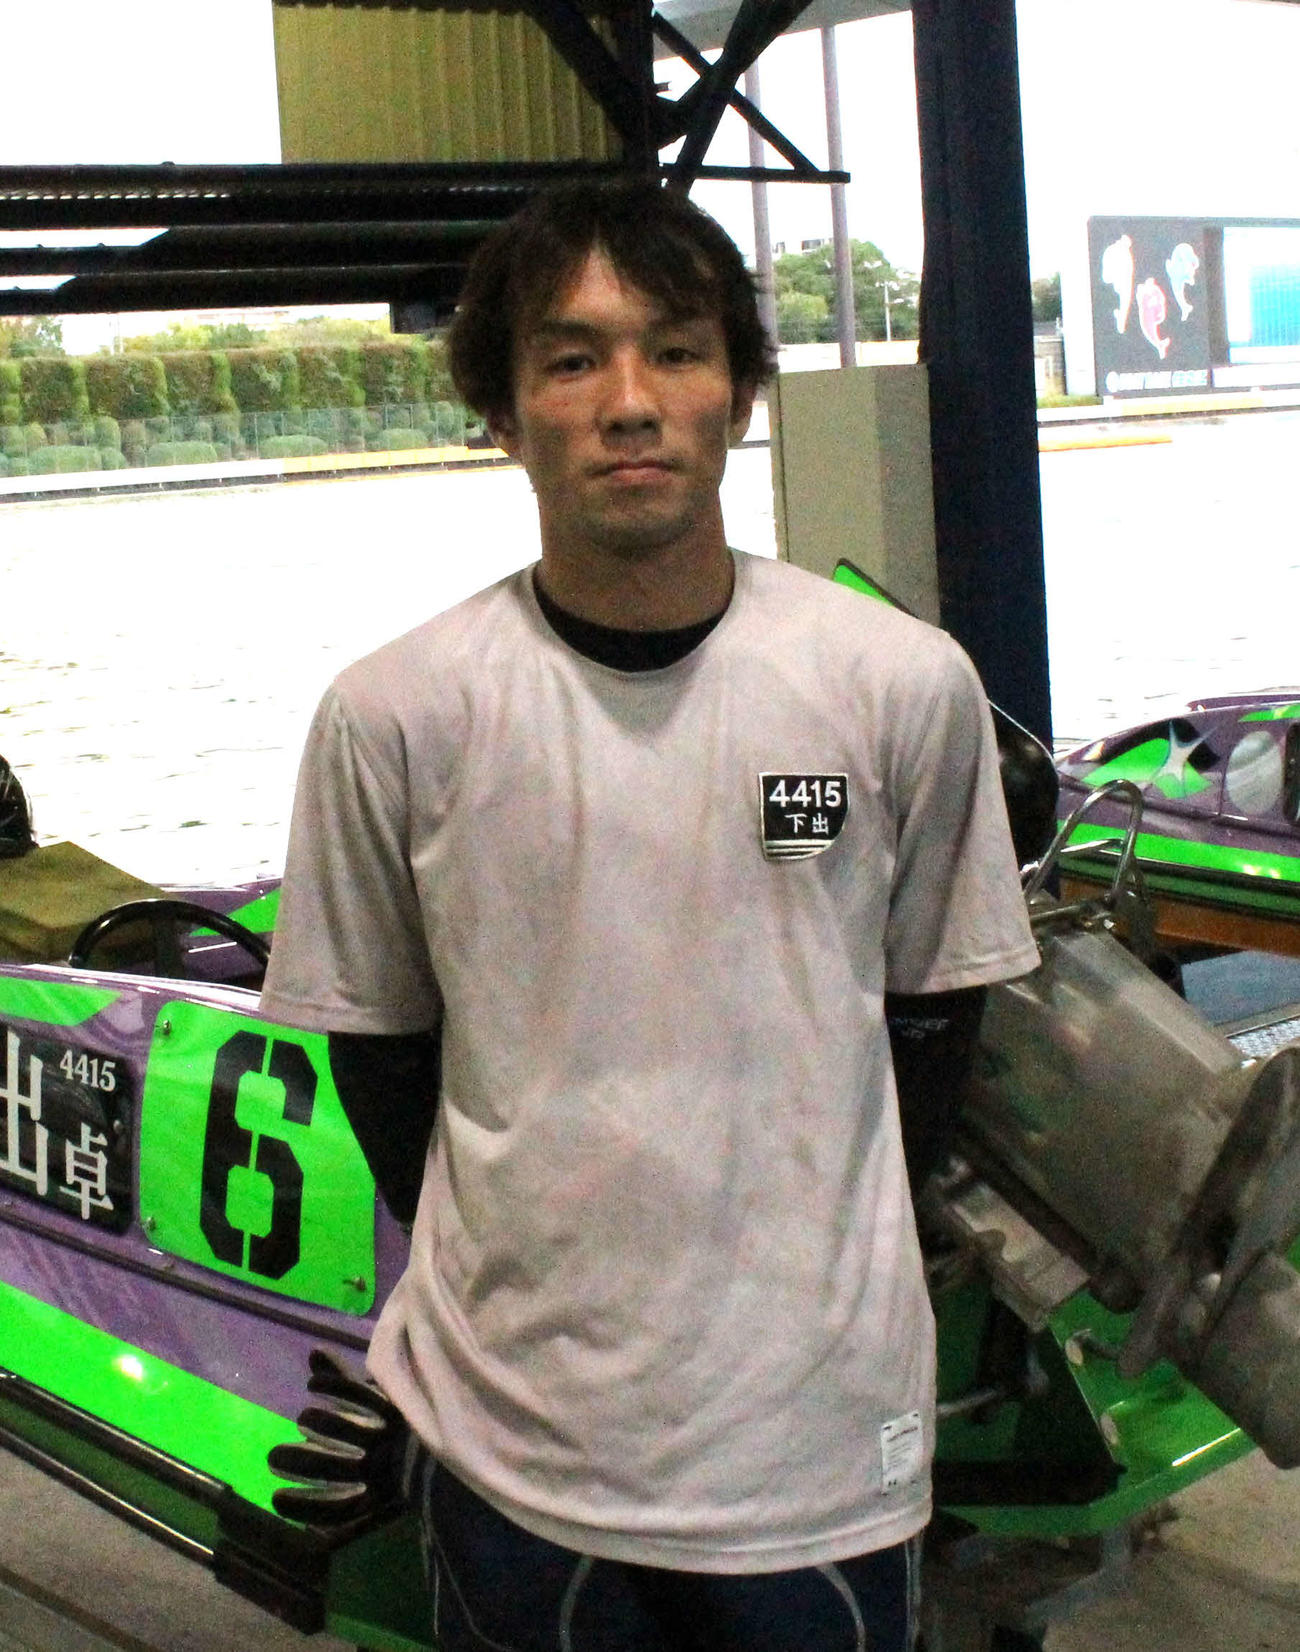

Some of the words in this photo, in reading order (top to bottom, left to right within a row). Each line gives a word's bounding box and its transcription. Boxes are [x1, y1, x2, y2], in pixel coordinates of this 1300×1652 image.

[769, 780, 841, 807] 4415
[784, 813, 828, 835] 下出
[59, 1050, 117, 1092] 4415
[59, 1122, 114, 1221] 卓
[200, 1030, 318, 1280] 6
